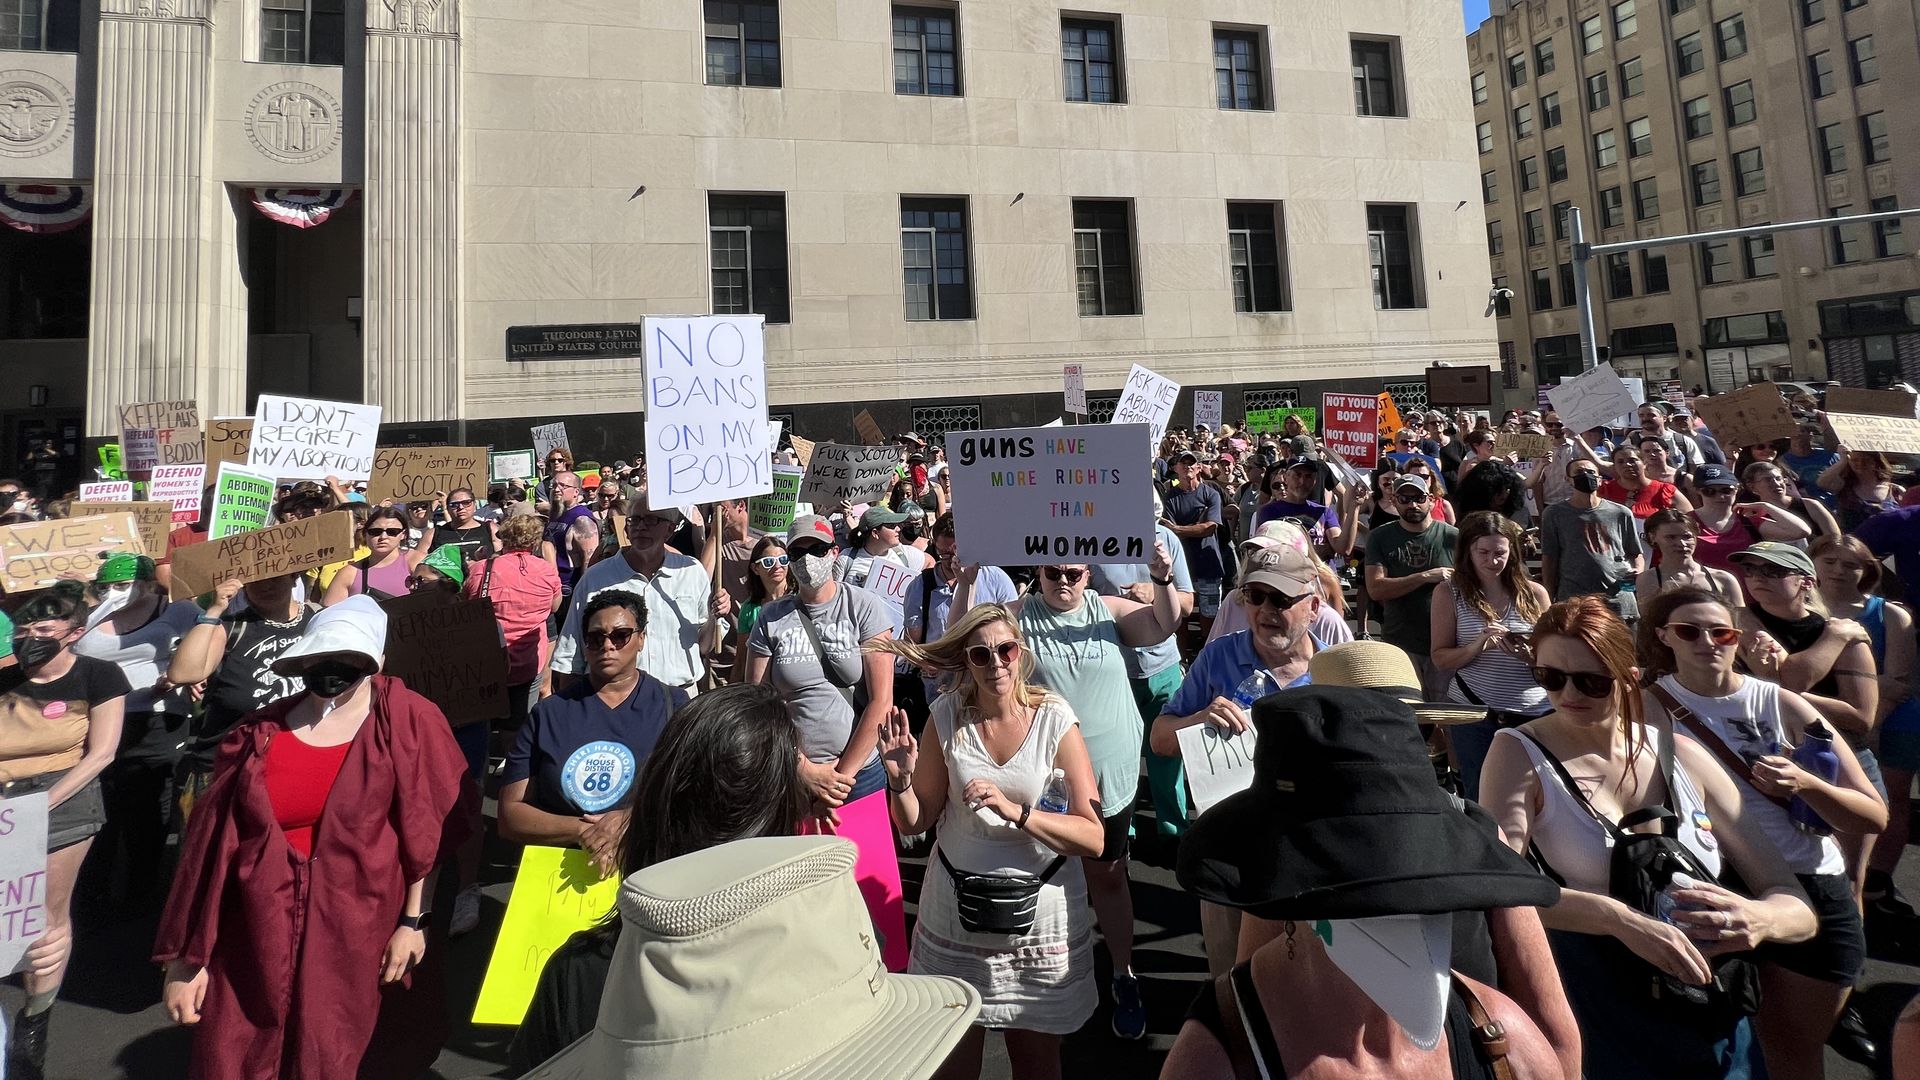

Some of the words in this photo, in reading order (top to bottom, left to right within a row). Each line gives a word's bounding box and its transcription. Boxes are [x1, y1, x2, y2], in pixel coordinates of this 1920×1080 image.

[542, 331, 602, 342] THEODORE
[606, 330, 638, 340] LEVIN
[512, 344, 555, 353] UNITED
[557, 342, 596, 352] STATES
[599, 341, 641, 351] COURTH
[656, 322, 745, 369] NO
[652, 374, 757, 410] BANS
[1129, 370, 1155, 393] ASK
[1154, 383, 1178, 406] ME
[165, 400, 197, 411] YOUR
[1197, 391, 1219, 403] FUCK
[1326, 396, 1346, 407] NOT
[1347, 397, 1376, 410] YOUR
[119, 402, 165, 429] KEEP
[263, 402, 268, 422] I
[1125, 393, 1165, 421] ABOUT
[1195, 410, 1220, 420] SCOTUS
[167, 411, 199, 429] LAWS
[1336, 410, 1364, 423] BODY
[157, 429, 175, 444] FF
[211, 421, 253, 443] Sorr
[259, 425, 362, 449] REGRET
[658, 424, 705, 452] ON
[722, 419, 755, 449] MY
[1326, 429, 1345, 441] NOT
[1346, 431, 1375, 443] YOUR
[1378, 426, 1394, 437] OUR
[163, 441, 201, 464] BODY
[817, 446, 850, 462] FUCK
[854, 448, 902, 463] SCOTUS
[959, 437, 1036, 466] guns
[1046, 439, 1086, 455] HAVE
[1332, 444, 1367, 457] CHOICE
[253, 447, 283, 466] MY
[282, 447, 372, 473] ABORTIONS
[425, 455, 453, 469] isn't
[456, 457, 477, 470] my
[155, 467, 203, 478] DEFEND
[668, 448, 770, 496] BODY!
[812, 464, 849, 480] WE'RE
[854, 465, 894, 480] DOING
[991, 470, 1037, 487] MORE
[1056, 469, 1121, 485] RIGHTS
[84, 483, 130, 496] DEFEND
[153, 480, 191, 488] WOMEN'S
[227, 480, 270, 497] ABORTION
[393, 473, 476, 498] SCOTUS
[808, 482, 823, 493] IT
[832, 482, 886, 498] ANYWAYS
[152, 489, 198, 498] REPRODUCTIVE
[219, 494, 234, 505] ON
[237, 494, 270, 511] DEMAND
[759, 505, 793, 515] WITHOUT
[1049, 501, 1095, 518] THAN
[221, 511, 228, 520] &
[754, 516, 787, 528] APOLOGY
[9, 523, 93, 552] WE
[217, 522, 310, 560] ABORTION
[230, 557, 242, 567] IS
[256, 543, 295, 561] BASIC
[1025, 535, 1144, 558] women
[875, 565, 912, 598] FUC
[567, 748, 591, 773] CHERI
[594, 745, 631, 773] HARDMON
[583, 773, 611, 792] 68
